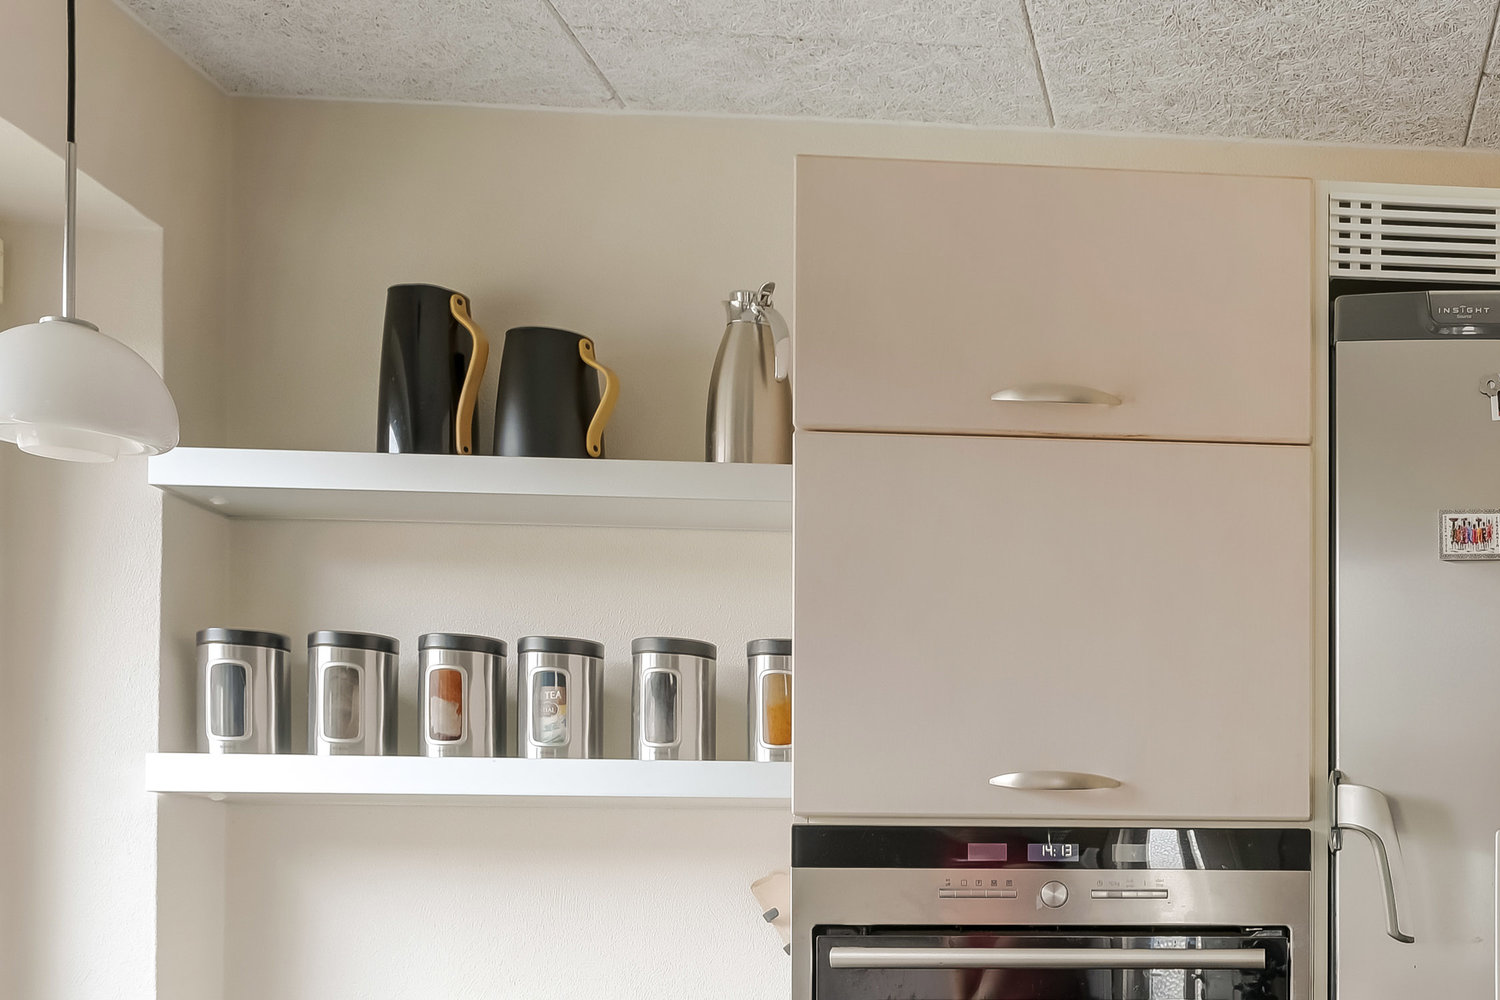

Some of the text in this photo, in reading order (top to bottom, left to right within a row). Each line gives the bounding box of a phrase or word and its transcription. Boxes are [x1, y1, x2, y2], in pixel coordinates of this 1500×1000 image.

[1438, 305, 1490, 314] INSIGHT
[544, 690, 562, 700] TEA
[1041, 844, 1072, 857] 14:13
